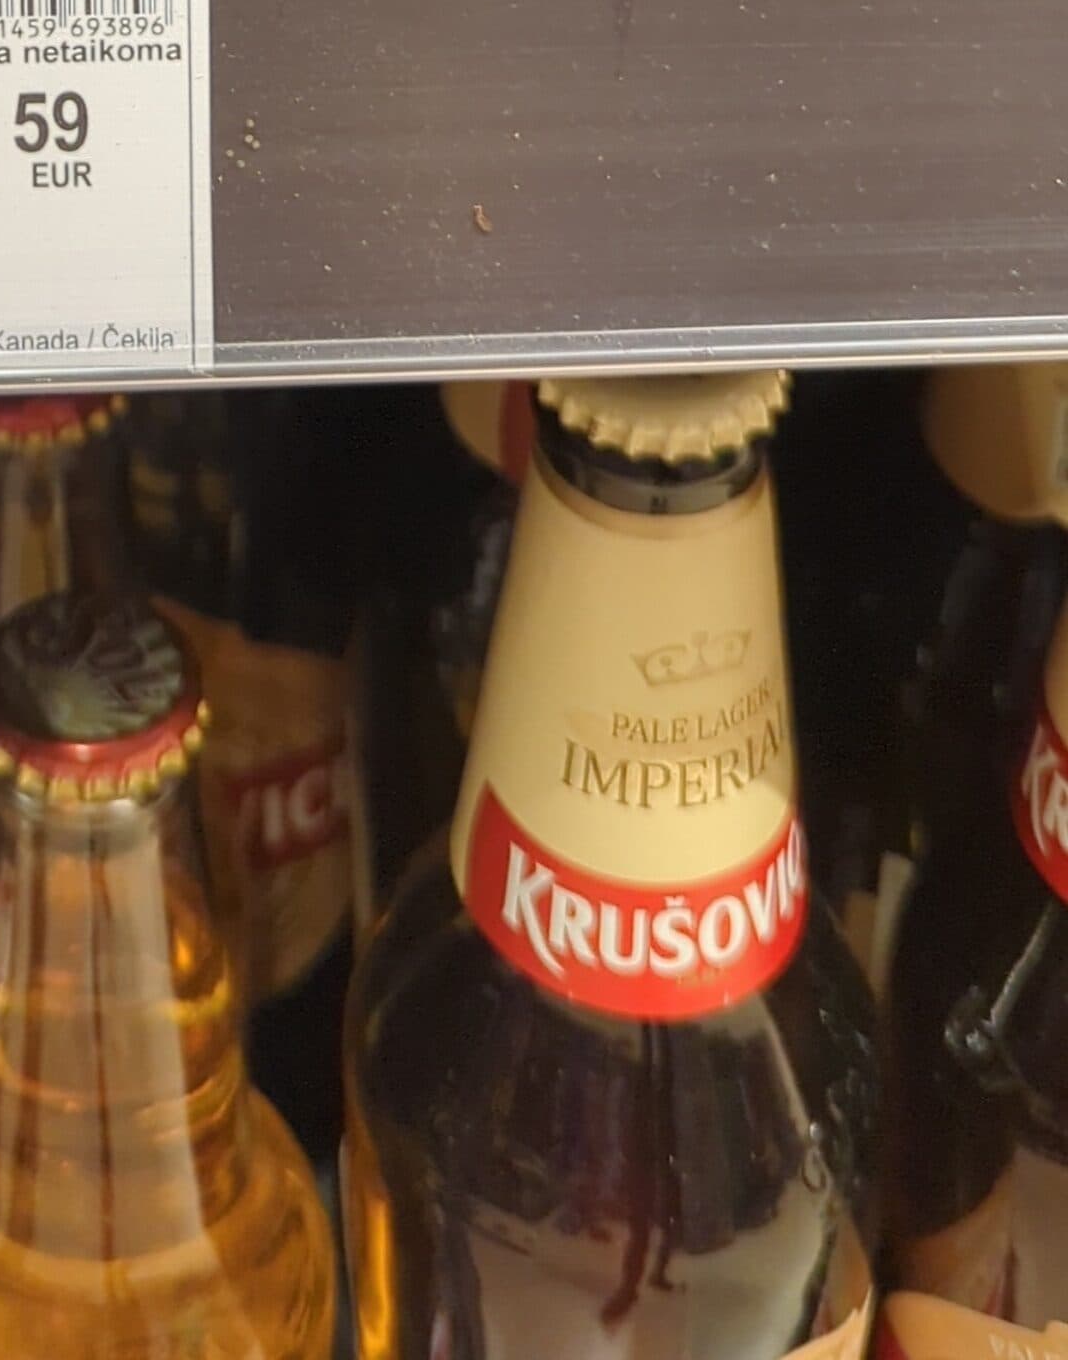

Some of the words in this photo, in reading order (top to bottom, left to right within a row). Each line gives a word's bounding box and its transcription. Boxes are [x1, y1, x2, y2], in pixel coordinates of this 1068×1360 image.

[23, 39, 182, 64] netaikoma
[14, 90, 89, 154] 59
[31, 161, 92, 188] EUR
[101, 322, 175, 353] Čekija
[611, 710, 689, 745] PALE
